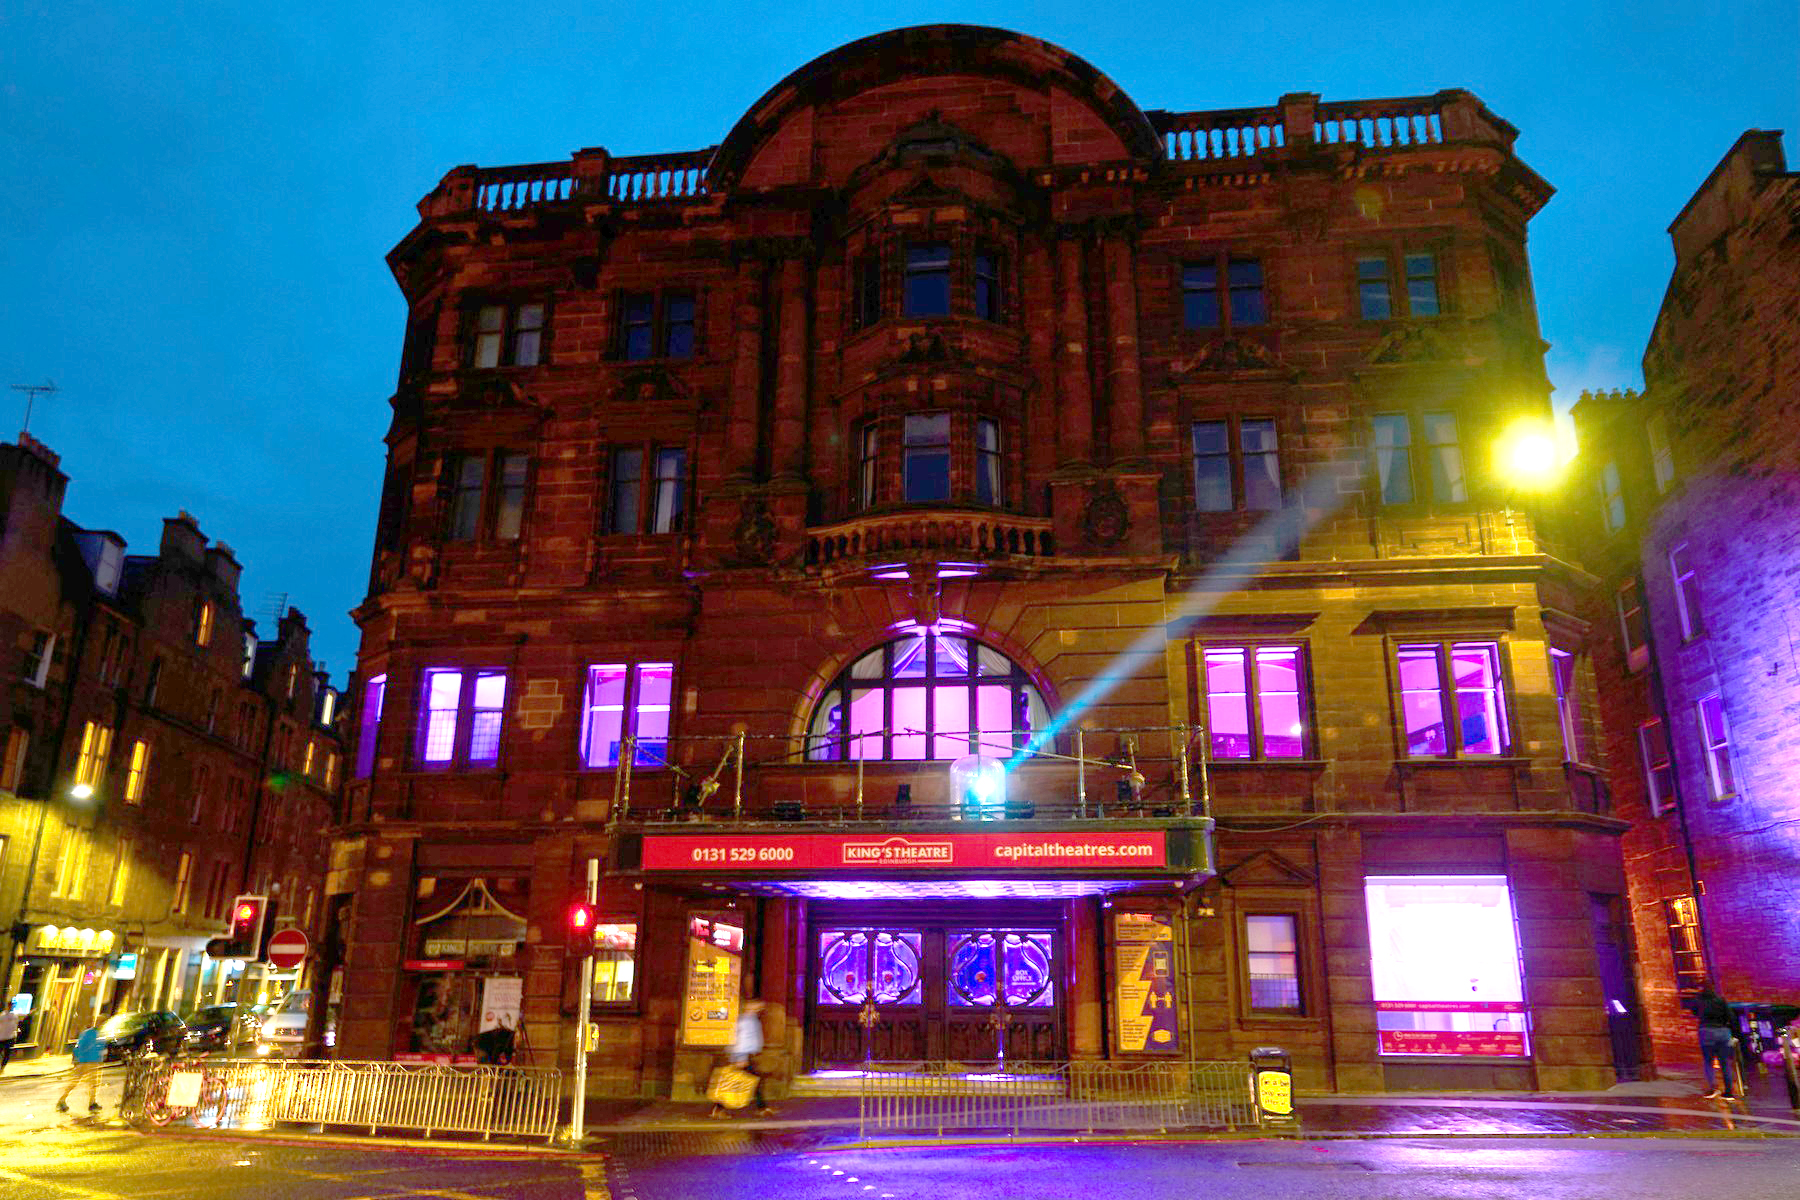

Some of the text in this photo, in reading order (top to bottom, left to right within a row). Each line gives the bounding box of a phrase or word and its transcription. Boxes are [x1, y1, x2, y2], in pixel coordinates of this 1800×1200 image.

[693, 847, 794, 861] 0131 529 6000
[848, 847, 948, 858] KING'S THEATRE
[994, 843, 1153, 861] capitaltheatres.com
